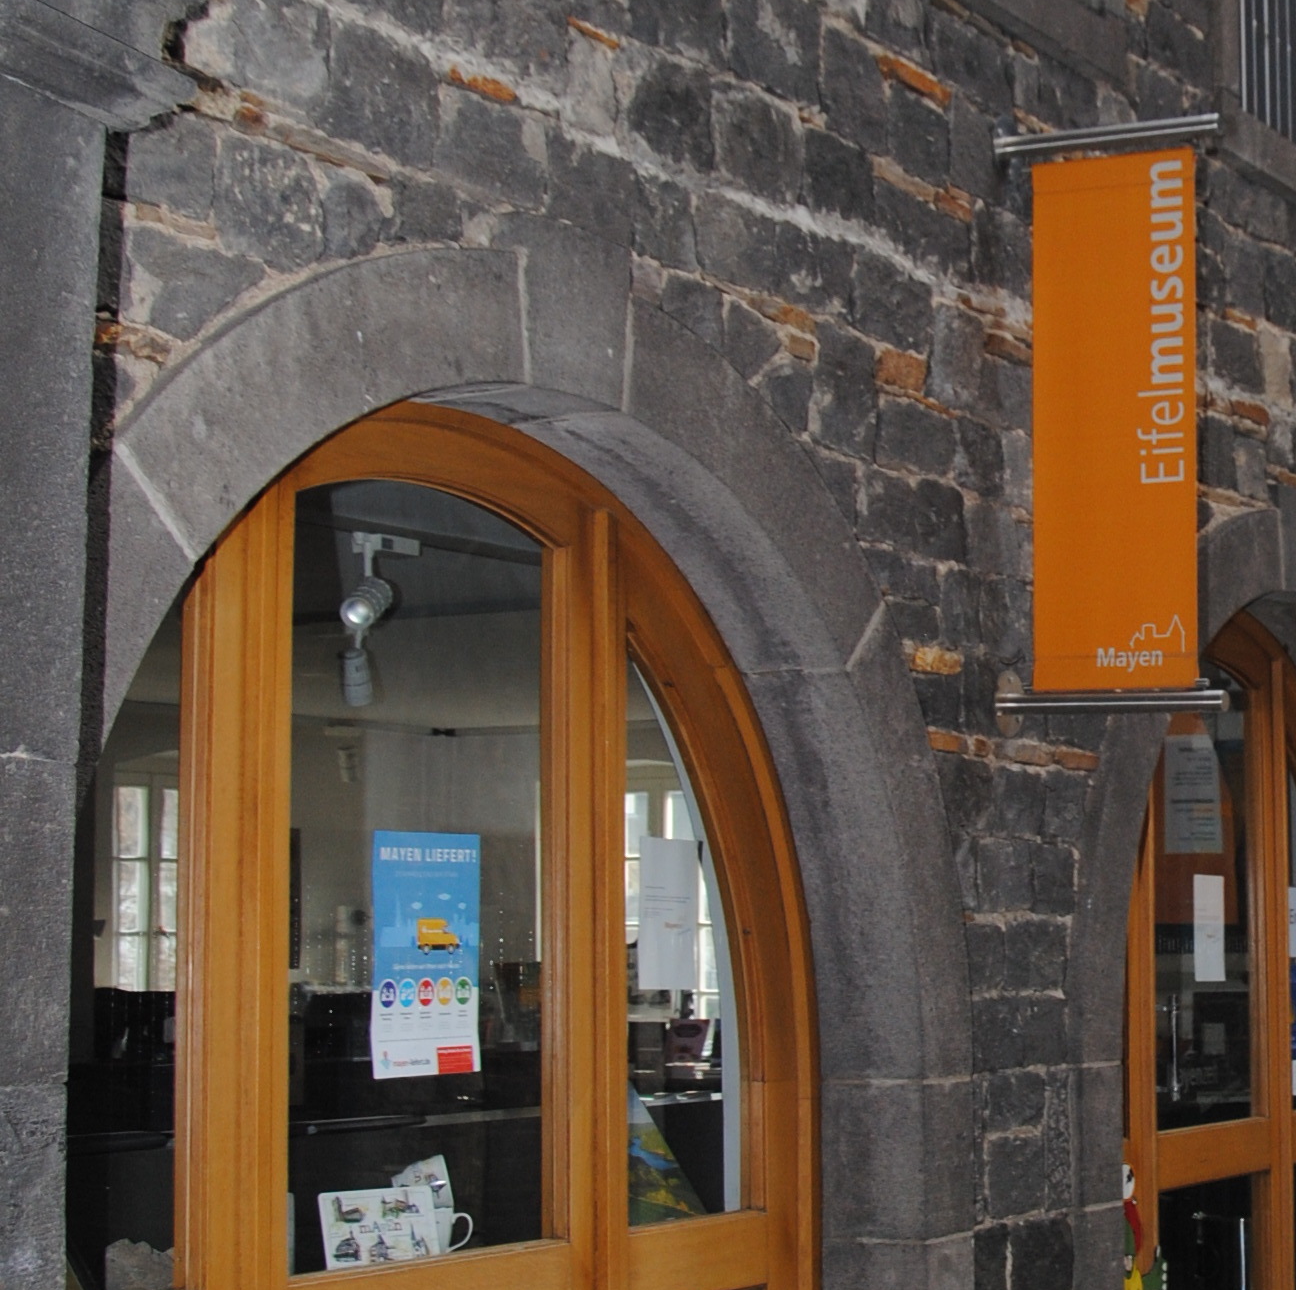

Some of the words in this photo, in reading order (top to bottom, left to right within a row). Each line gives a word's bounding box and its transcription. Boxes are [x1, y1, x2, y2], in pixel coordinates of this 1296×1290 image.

[1137, 159, 1185, 485] Eifelmuseum
[1096, 647, 1163, 672] Mayen
[380, 847, 422, 862] MAYEN
[425, 848, 477, 863] LIEFERT!
